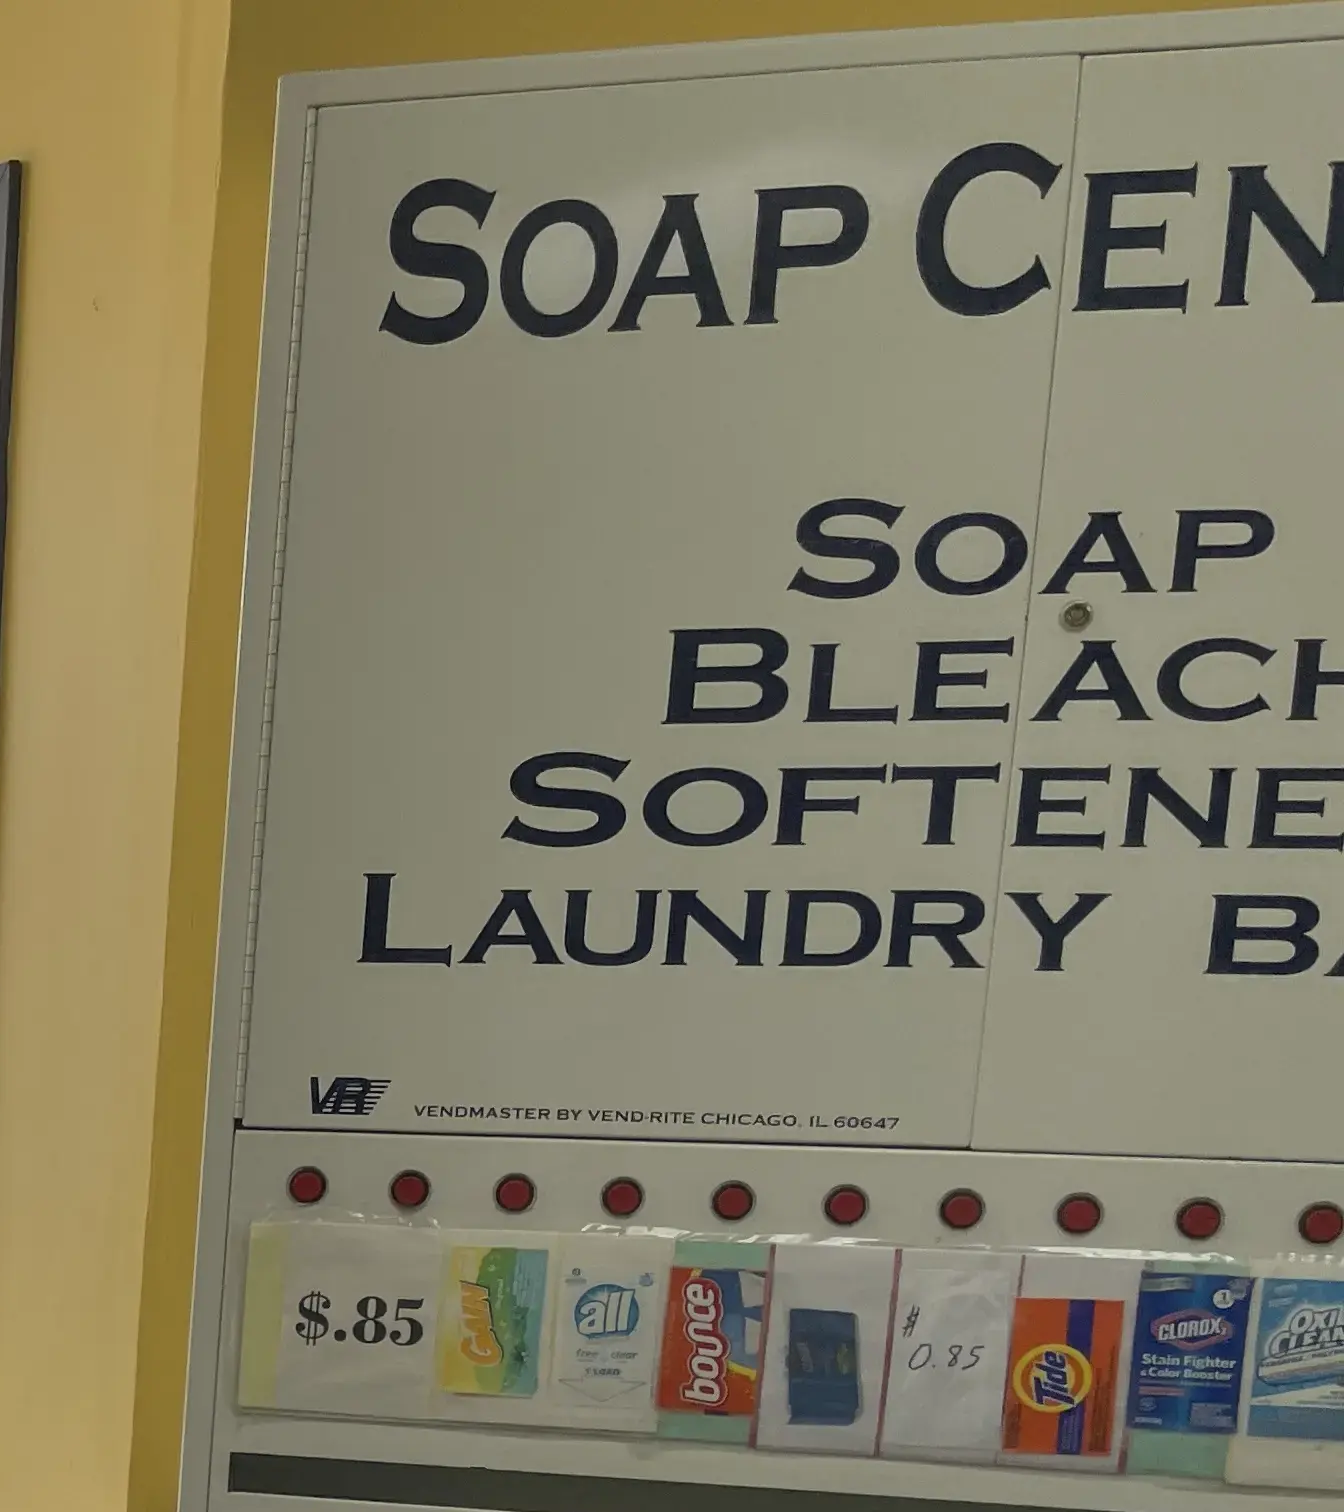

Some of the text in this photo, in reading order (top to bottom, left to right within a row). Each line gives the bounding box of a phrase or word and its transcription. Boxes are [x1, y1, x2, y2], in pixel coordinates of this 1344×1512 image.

[378, 178, 869, 344] SOAP
[787, 499, 1275, 598] SOAP
[356, 873, 1344, 976] LAUNDRY B
[414, 1104, 551, 1121] VENDMASTER
[556, 1108, 583, 1122] BY
[588, 1109, 695, 1125] VEND-RITE
[809, 1115, 828, 1128] IL
[833, 1116, 900, 1130] 60647
[294, 1292, 426, 1348] $.85
[578, 1289, 636, 1336] all
[1158, 1317, 1223, 1342] CLOROX
[682, 1280, 723, 1406] bounce
[908, 1343, 985, 1371] 0.85
[1141, 1353, 1237, 1370] Stain Fighter
[1031, 1351, 1077, 1409] Tide
[1148, 1367, 1181, 1378] Color
[1183, 1369, 1233, 1381] Booster
